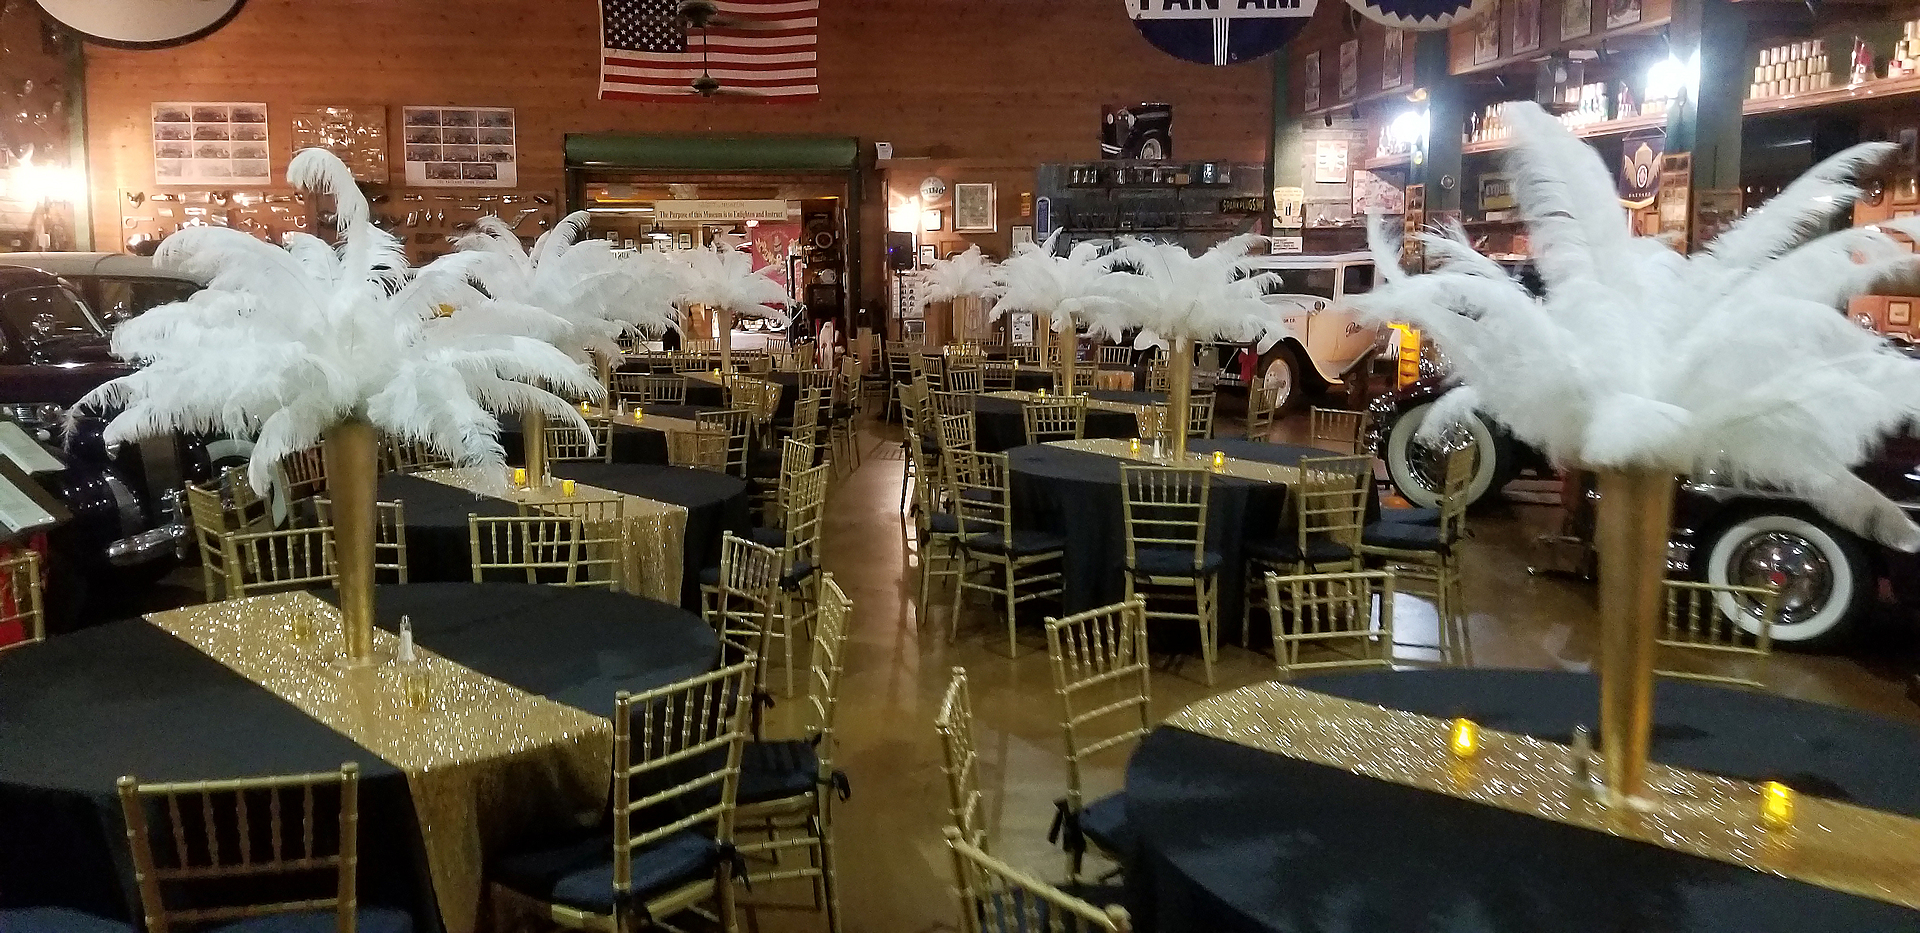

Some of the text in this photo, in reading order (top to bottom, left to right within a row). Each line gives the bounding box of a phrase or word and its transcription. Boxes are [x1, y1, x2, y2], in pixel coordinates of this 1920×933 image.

[659, 210, 668, 219] The
[669, 210, 688, 219] Purpose
[693, 210, 703, 219] this
[703, 210, 723, 219] Museum
[733, 210, 755, 219] Enlighten
[755, 210, 764, 219] and
[764, 210, 783, 218] Instruct
